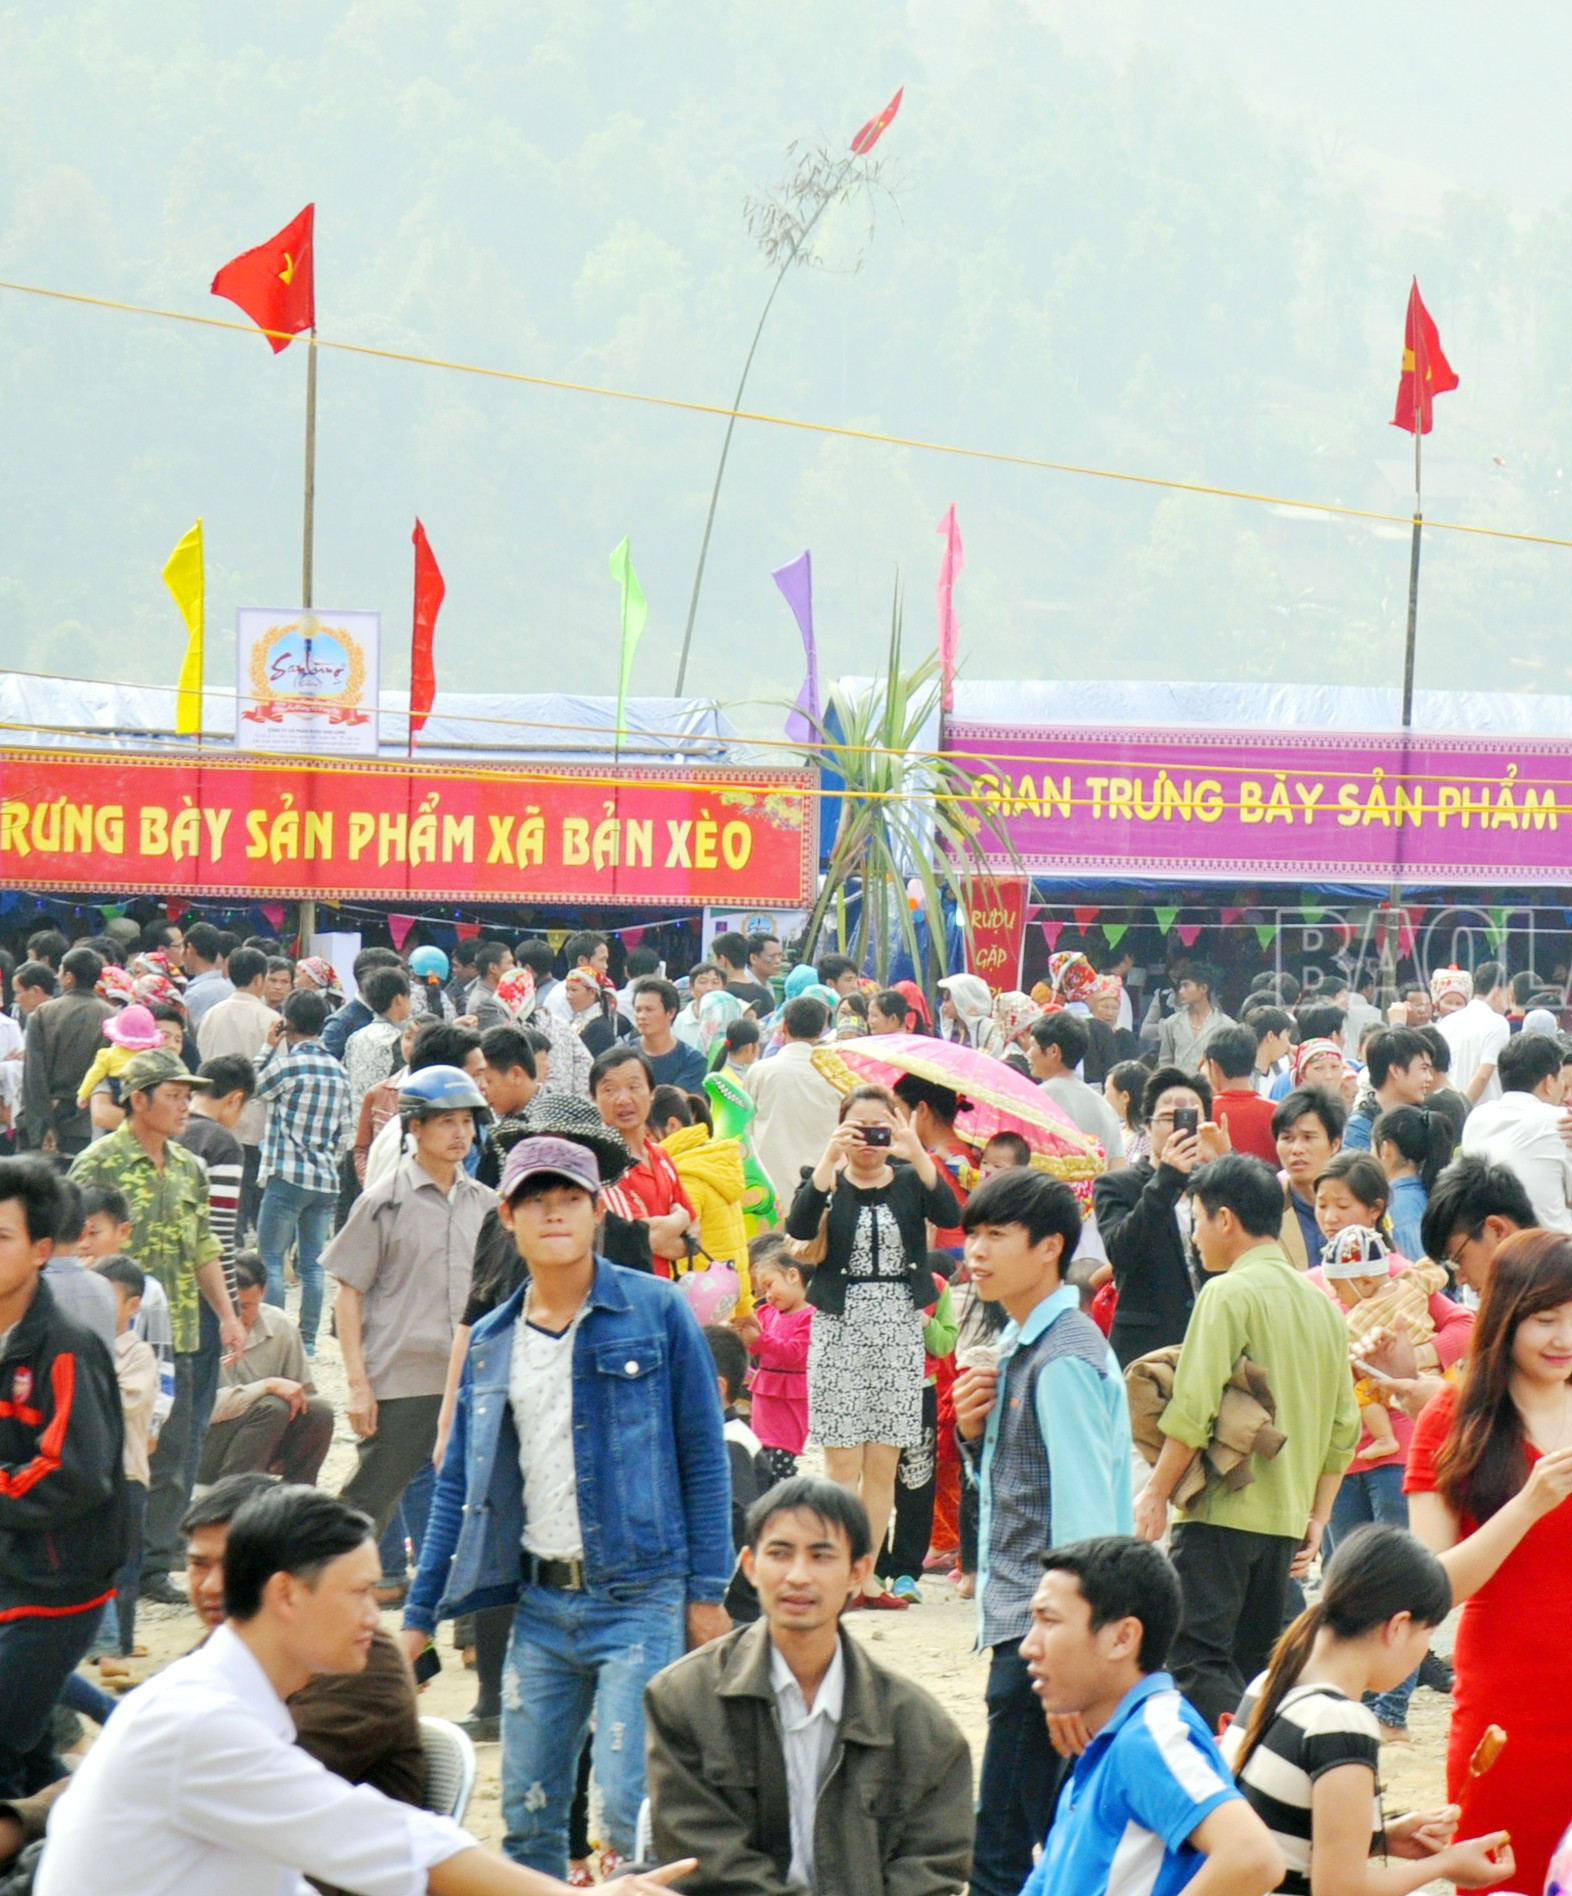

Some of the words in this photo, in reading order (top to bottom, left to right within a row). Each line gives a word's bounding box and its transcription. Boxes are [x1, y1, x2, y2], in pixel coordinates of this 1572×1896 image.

[971, 772, 1072, 819] GIAN
[1086, 769, 1223, 822] TRƯNG
[1239, 774, 1324, 825] BÀY
[1337, 767, 1422, 827] SẢN
[1438, 763, 1558, 831] PHẨM
[139, 795, 232, 863] BÀY
[246, 792, 333, 865] SẢN
[348, 792, 475, 868] PHẨM
[486, 805, 545, 871] XÃ
[562, 800, 653, 872] BẢN
[665, 808, 753, 871] XÈO
[976, 944, 1008, 973] GẶP
